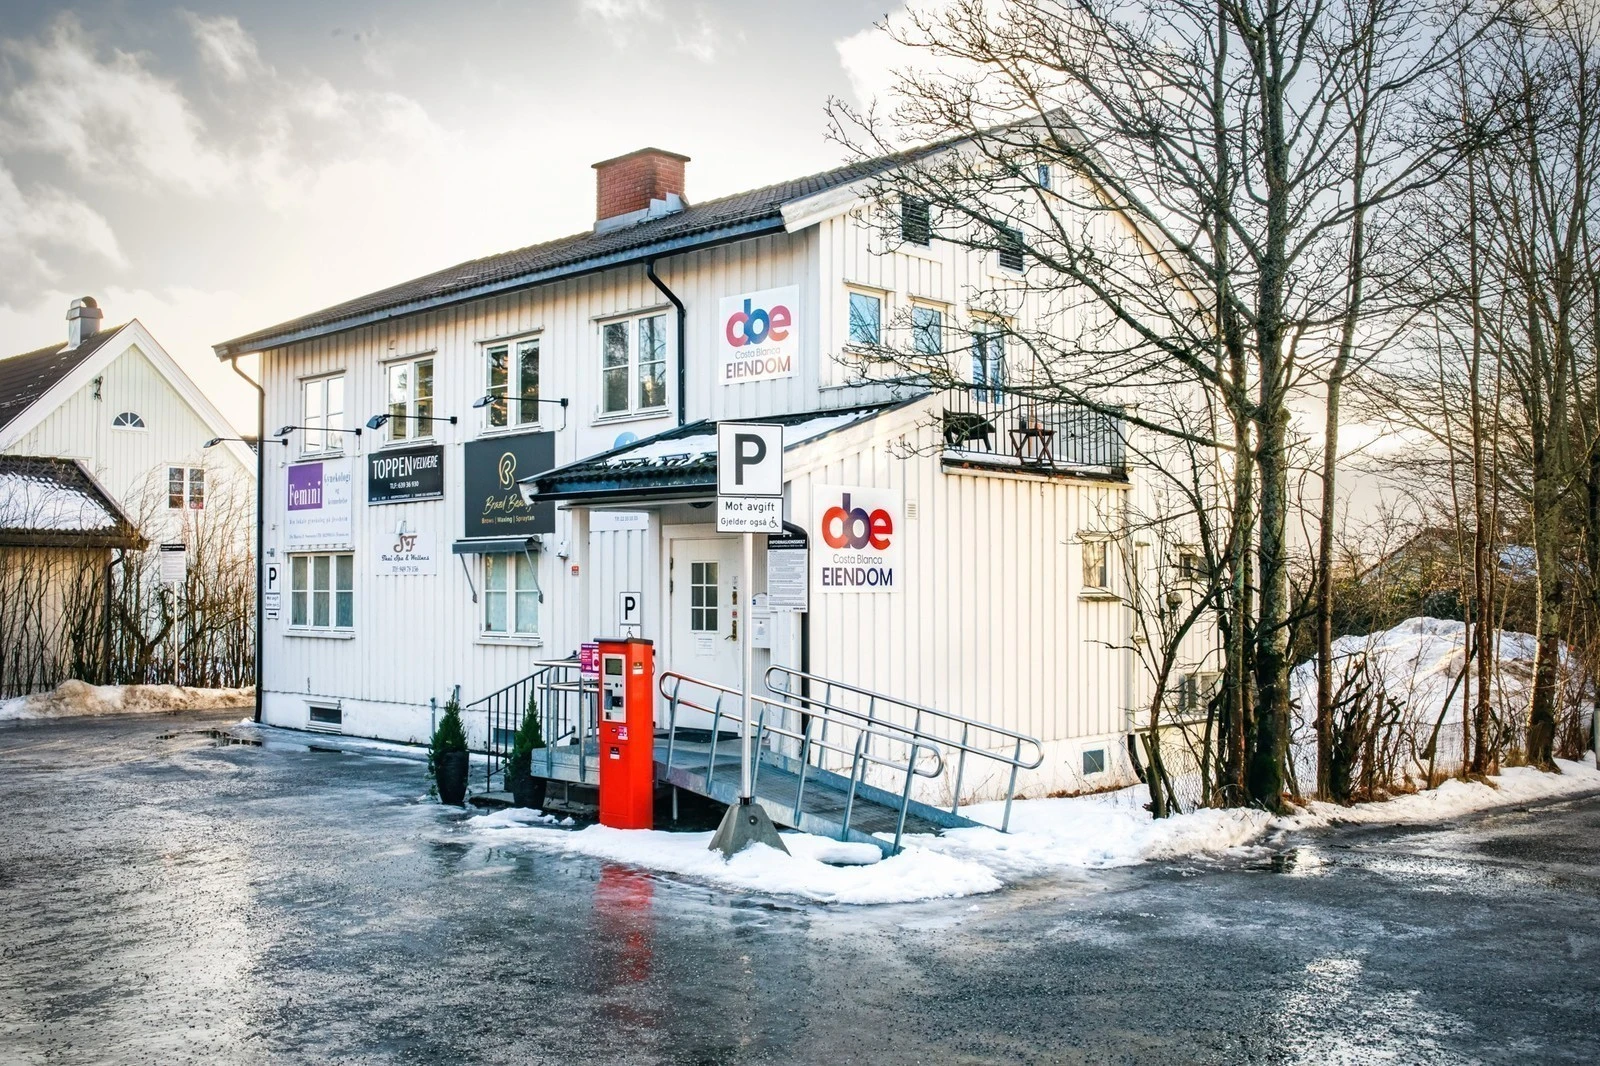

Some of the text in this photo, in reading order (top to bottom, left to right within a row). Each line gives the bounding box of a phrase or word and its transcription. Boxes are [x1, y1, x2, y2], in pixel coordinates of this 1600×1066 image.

[735, 347, 780, 360] Costa Blanca
[726, 355, 791, 379] EIENDOM
[373, 455, 439, 480] TOPPEN VELVÆRE
[735, 433, 767, 486] P
[324, 472, 351, 485] Gynekologi
[289, 480, 321, 506] Femini
[725, 501, 775, 513] Mot avgift
[497, 516, 512, 524] Waxing
[515, 515, 535, 523] Spraytan
[720, 517, 767, 527] Gjelder også
[394, 554, 404, 562] Spa
[832, 554, 883, 564] Costa Blanca
[269, 567, 277, 590] P
[822, 567, 893, 586] EIENDOM
[624, 596, 636, 621] P
